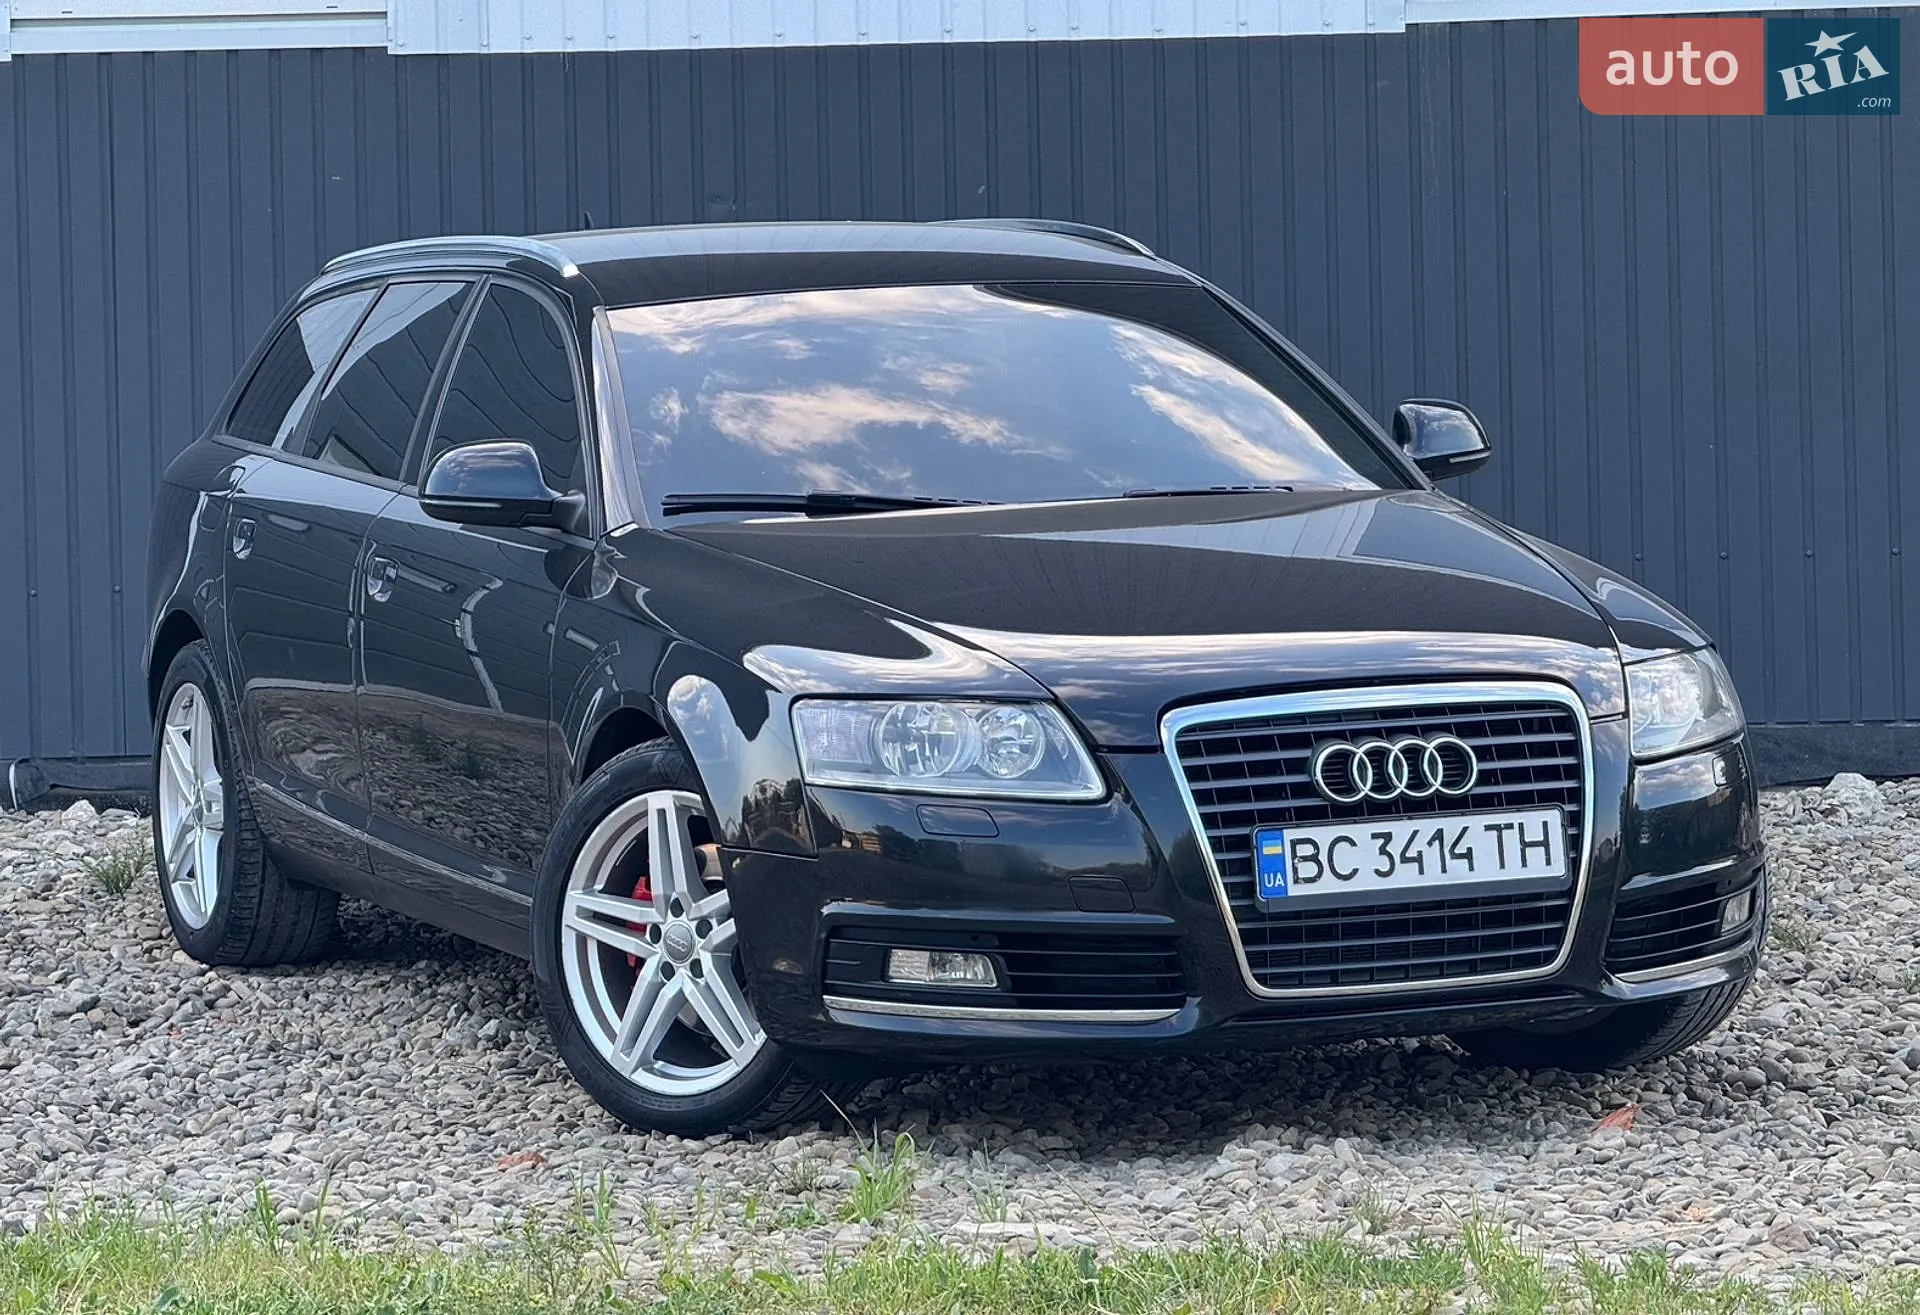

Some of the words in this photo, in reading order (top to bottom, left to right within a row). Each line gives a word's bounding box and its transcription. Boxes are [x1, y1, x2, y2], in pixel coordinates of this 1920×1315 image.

[1289, 835, 1360, 885] BC
[1370, 826, 1475, 878] 3414
[1484, 820, 1552, 870] TH
[1264, 872, 1285, 888] UA
